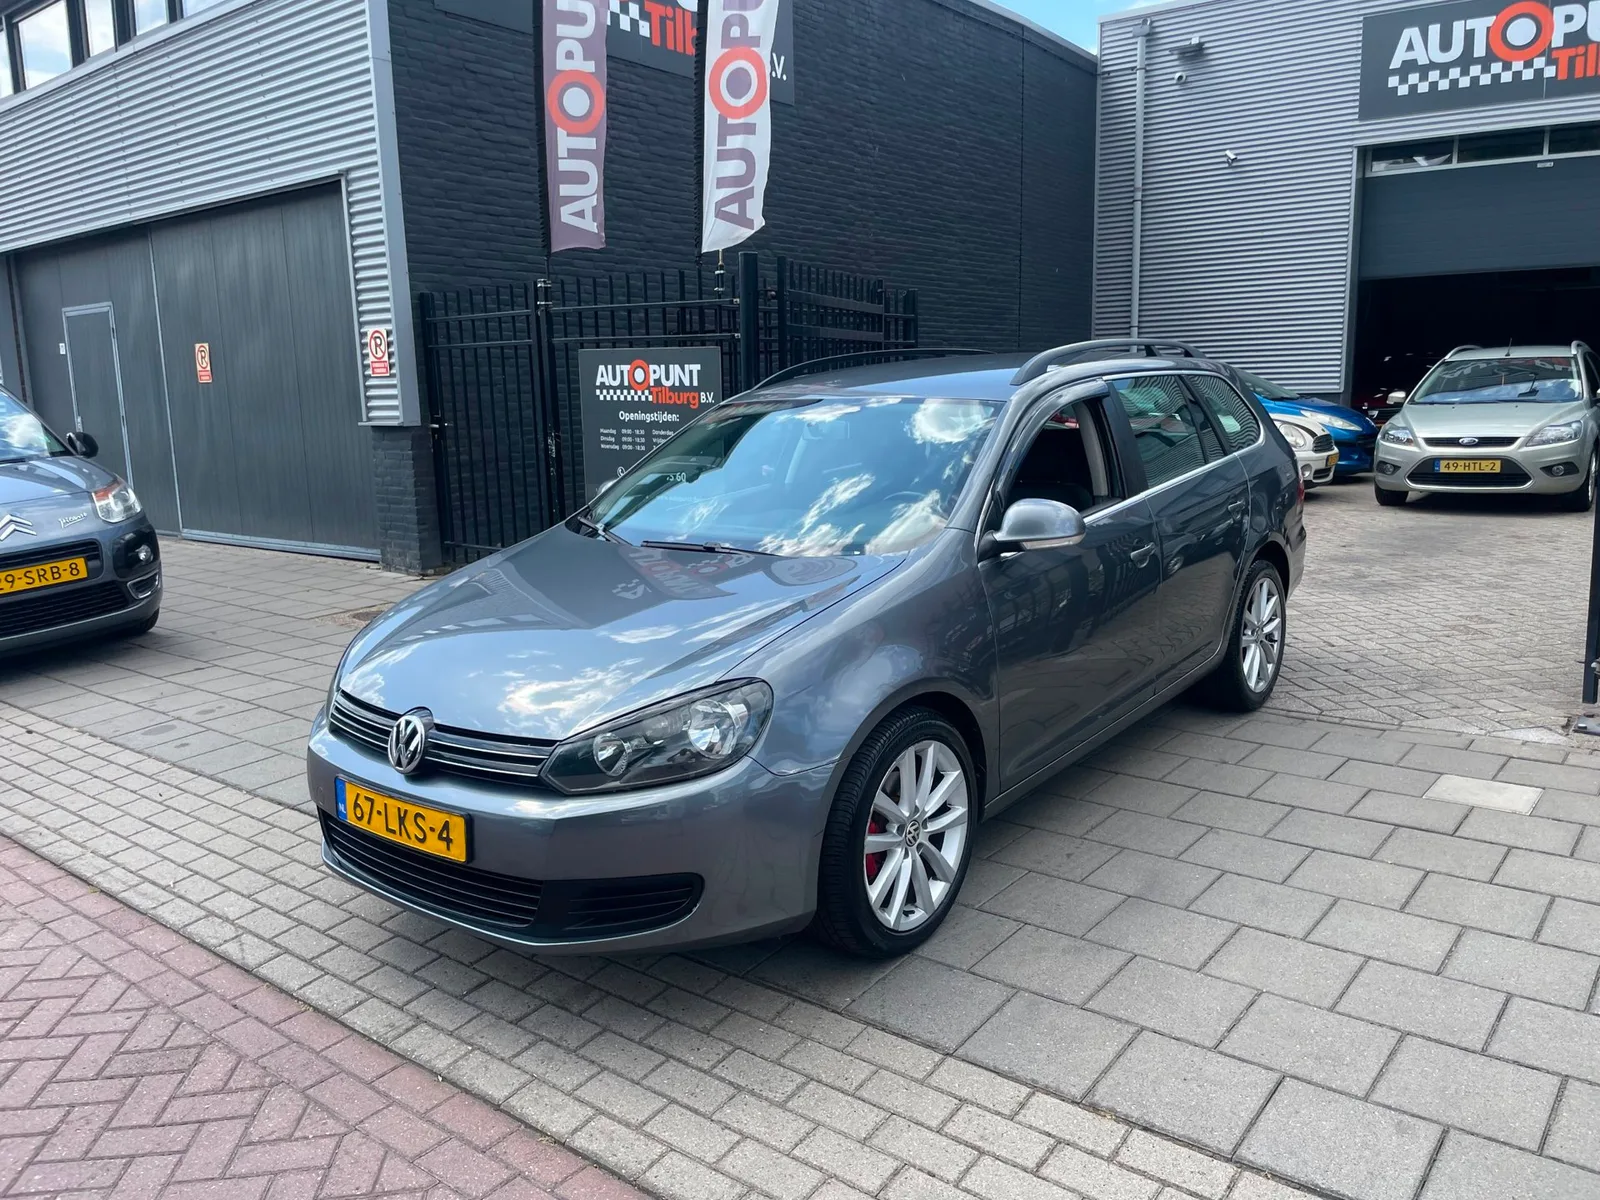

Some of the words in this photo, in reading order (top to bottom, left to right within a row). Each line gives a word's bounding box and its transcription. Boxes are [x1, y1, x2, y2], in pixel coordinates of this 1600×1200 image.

[1551, 43, 1600, 80] Til
[596, 359, 701, 391] AUTOPUNT
[650, 387, 699, 409] Tilburg
[700, 392, 715, 403] B.V.
[619, 411, 680, 423] Openingstijden:
[1444, 462, 1496, 471] 49-HTL-2
[353, 792, 453, 852] 67-LKS-4
